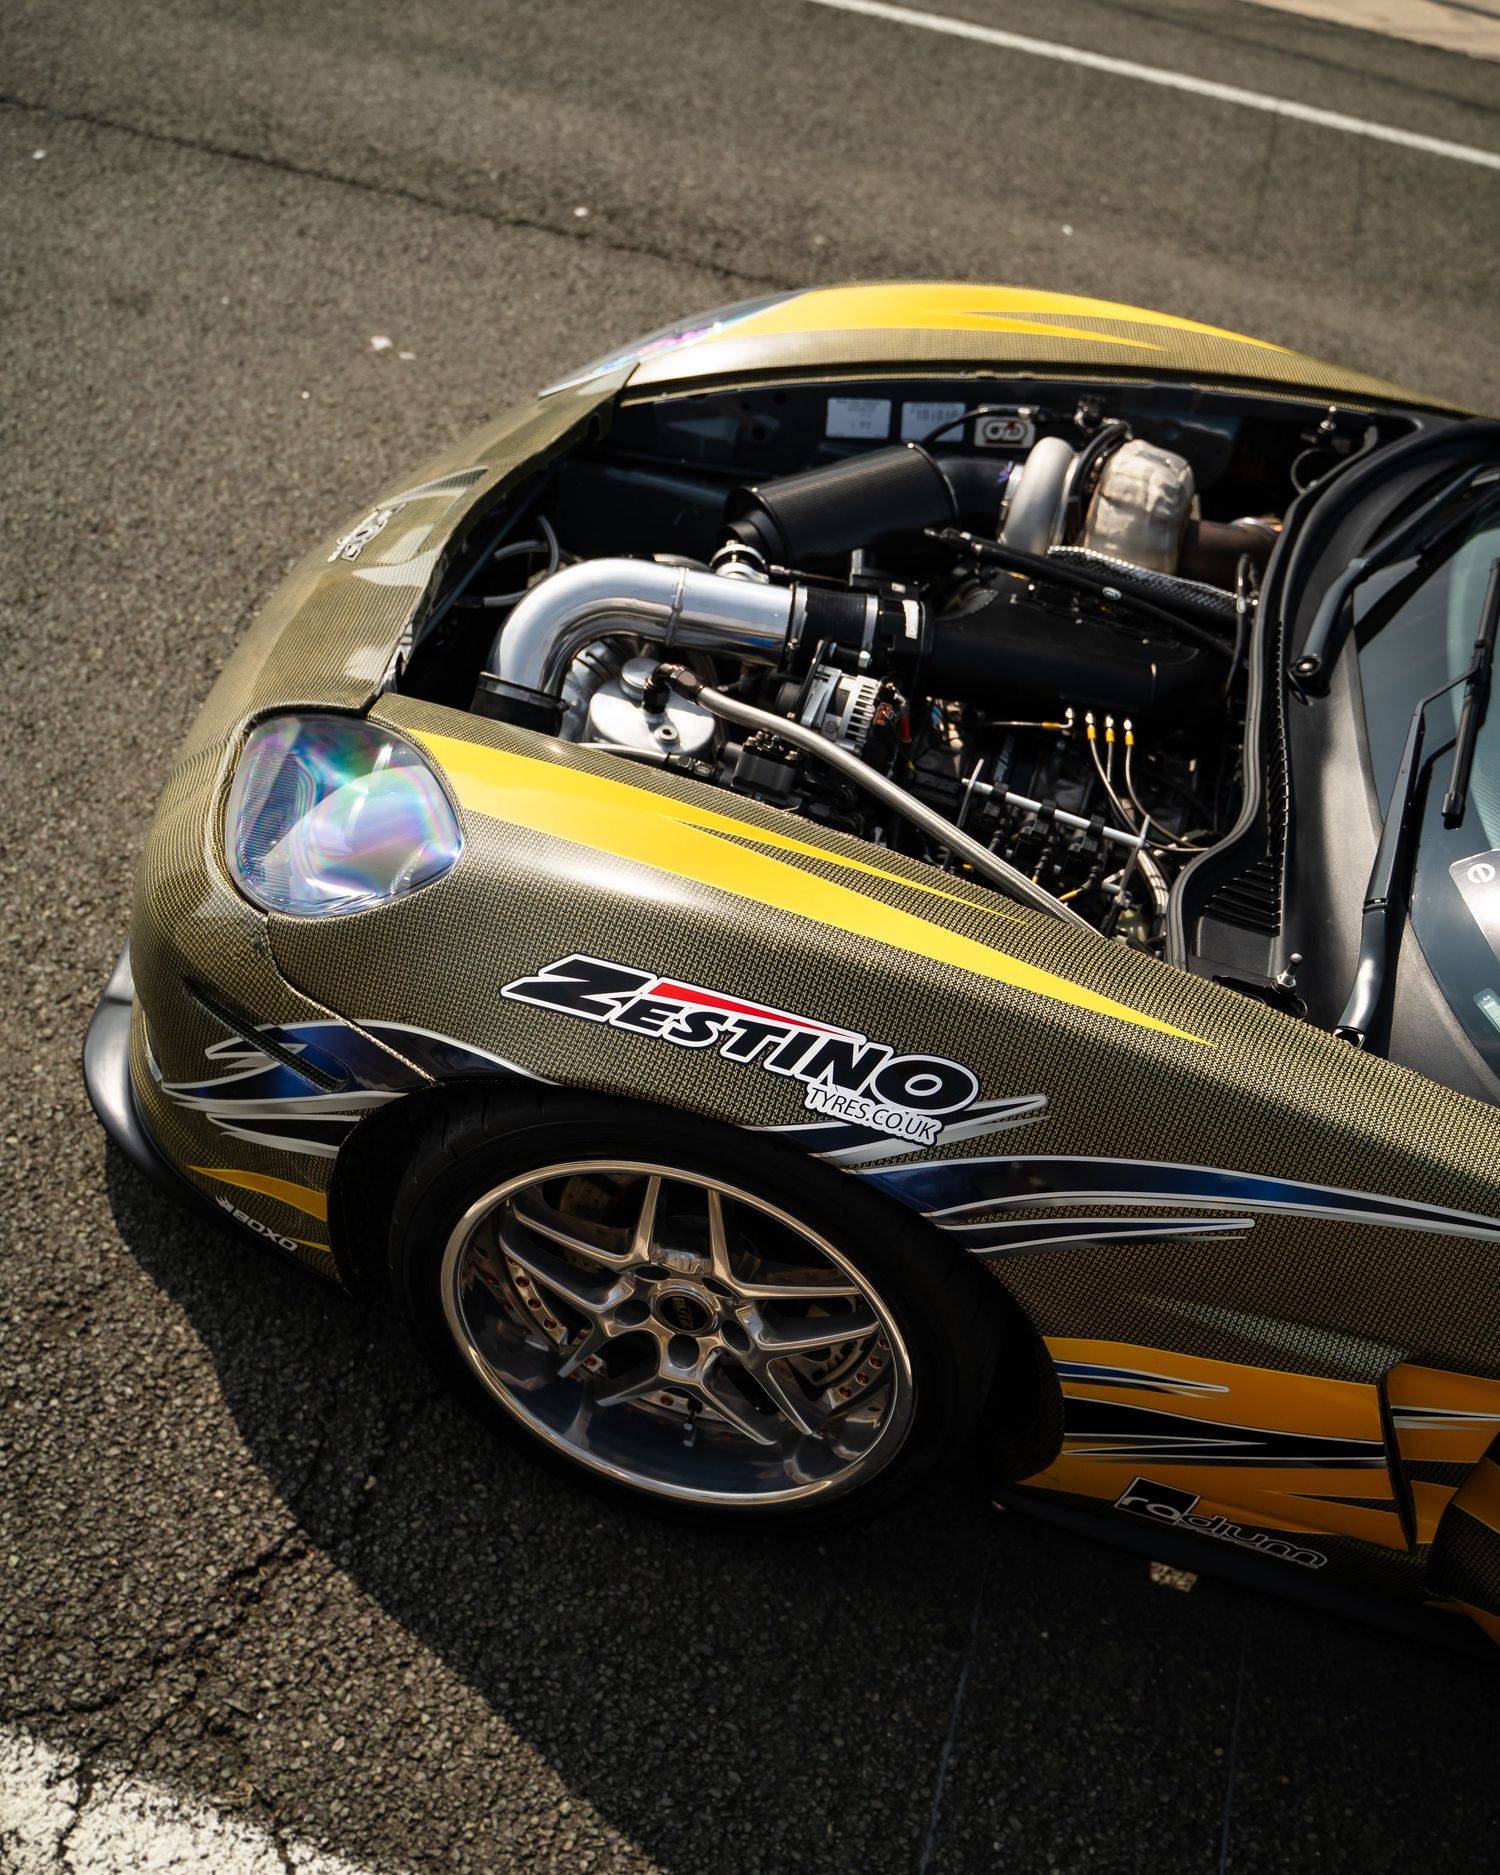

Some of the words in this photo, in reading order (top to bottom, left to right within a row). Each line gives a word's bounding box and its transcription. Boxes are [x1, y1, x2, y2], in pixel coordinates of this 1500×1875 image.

[502, 955, 979, 1113] ZESTINO
[808, 1085, 938, 1142] TYRES.CO.UK
[232, 1208, 298, 1251] BOXO
[1119, 1495, 1328, 1569] radium
